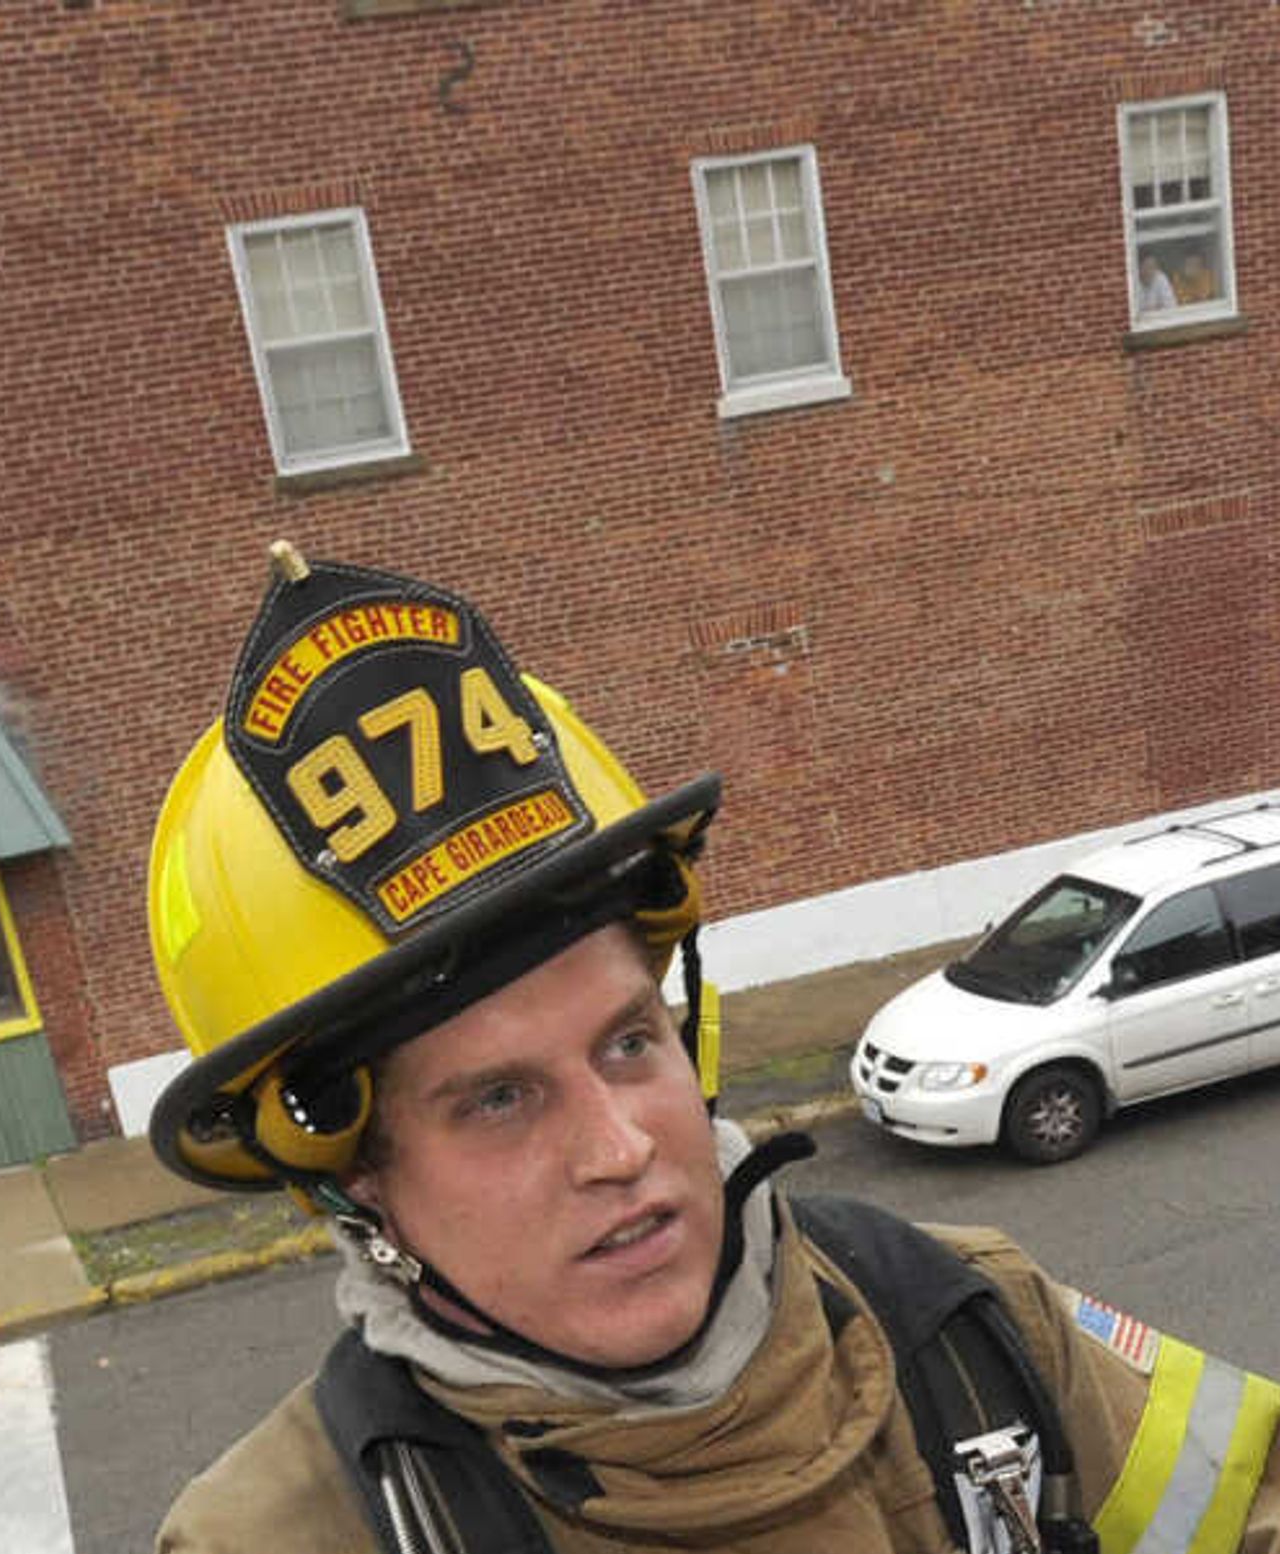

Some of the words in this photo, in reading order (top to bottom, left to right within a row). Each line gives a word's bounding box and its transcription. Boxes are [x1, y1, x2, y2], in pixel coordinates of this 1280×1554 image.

[250, 655, 313, 734] FIRE
[310, 605, 449, 660] FIGHTER
[287, 667, 539, 863] 974
[386, 855, 448, 913] CAPE
[446, 793, 569, 871] GIRARDEAU
